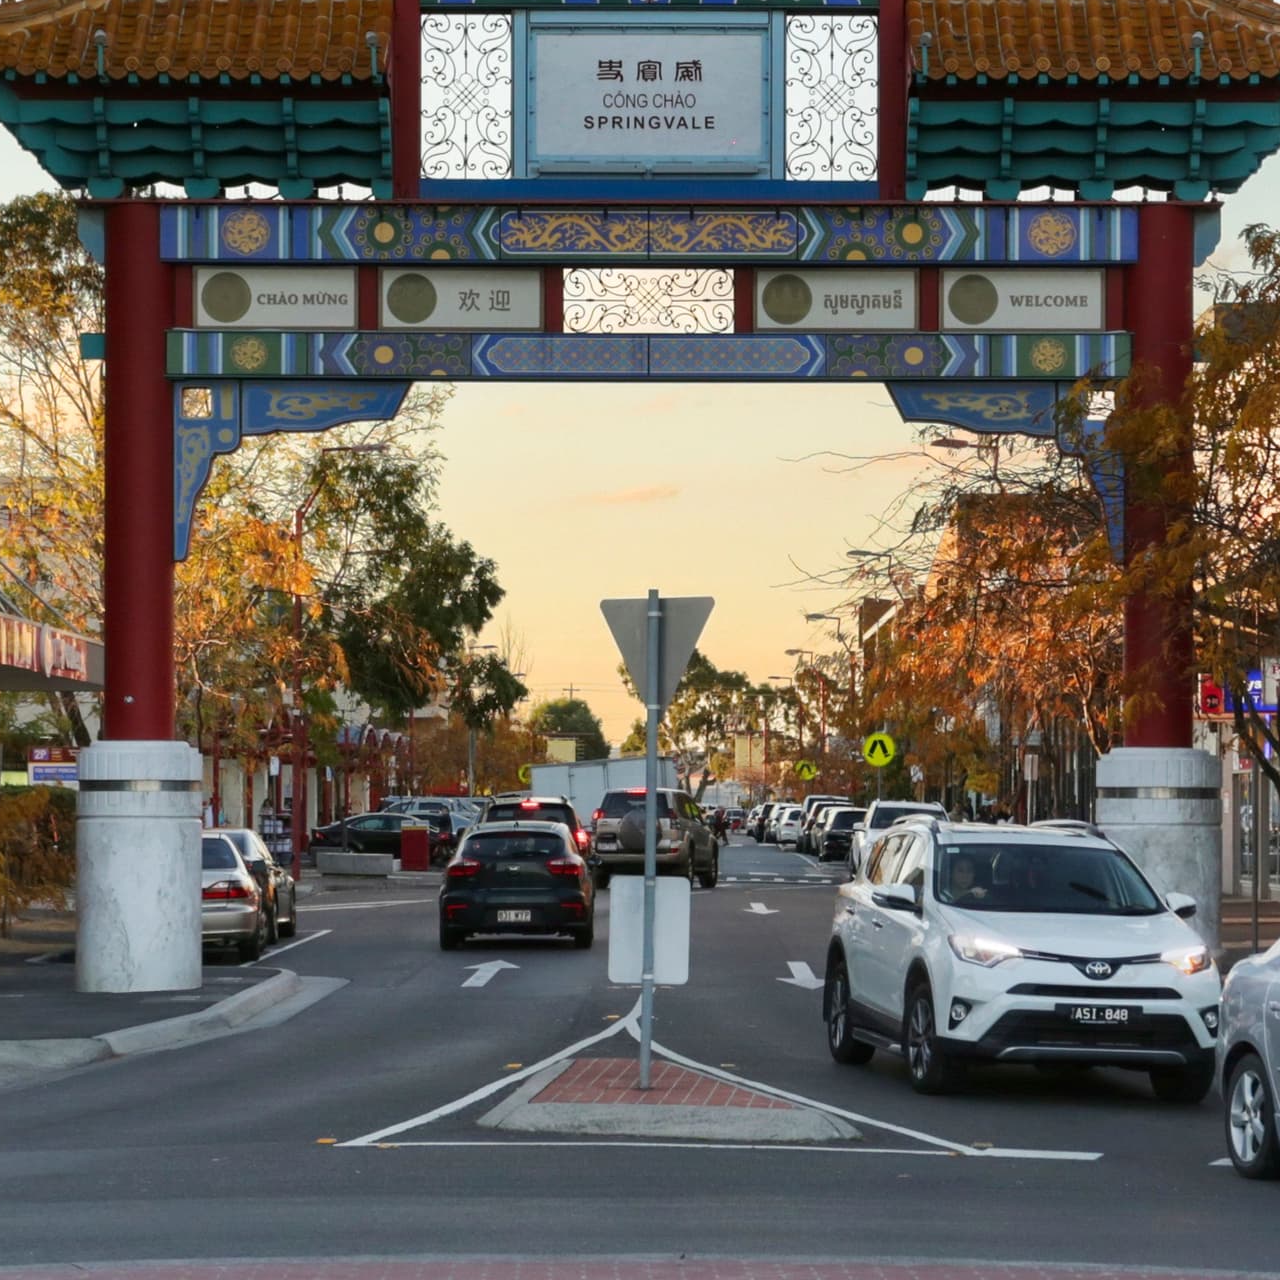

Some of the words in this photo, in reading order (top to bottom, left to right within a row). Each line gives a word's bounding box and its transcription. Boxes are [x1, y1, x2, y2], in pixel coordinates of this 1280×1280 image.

[583, 115, 716, 130] SPRINGVALE
[256, 290, 299, 306] CHÀO
[458, 288, 511, 312] 欢迎
[1009, 295, 1089, 308] WELCOME
